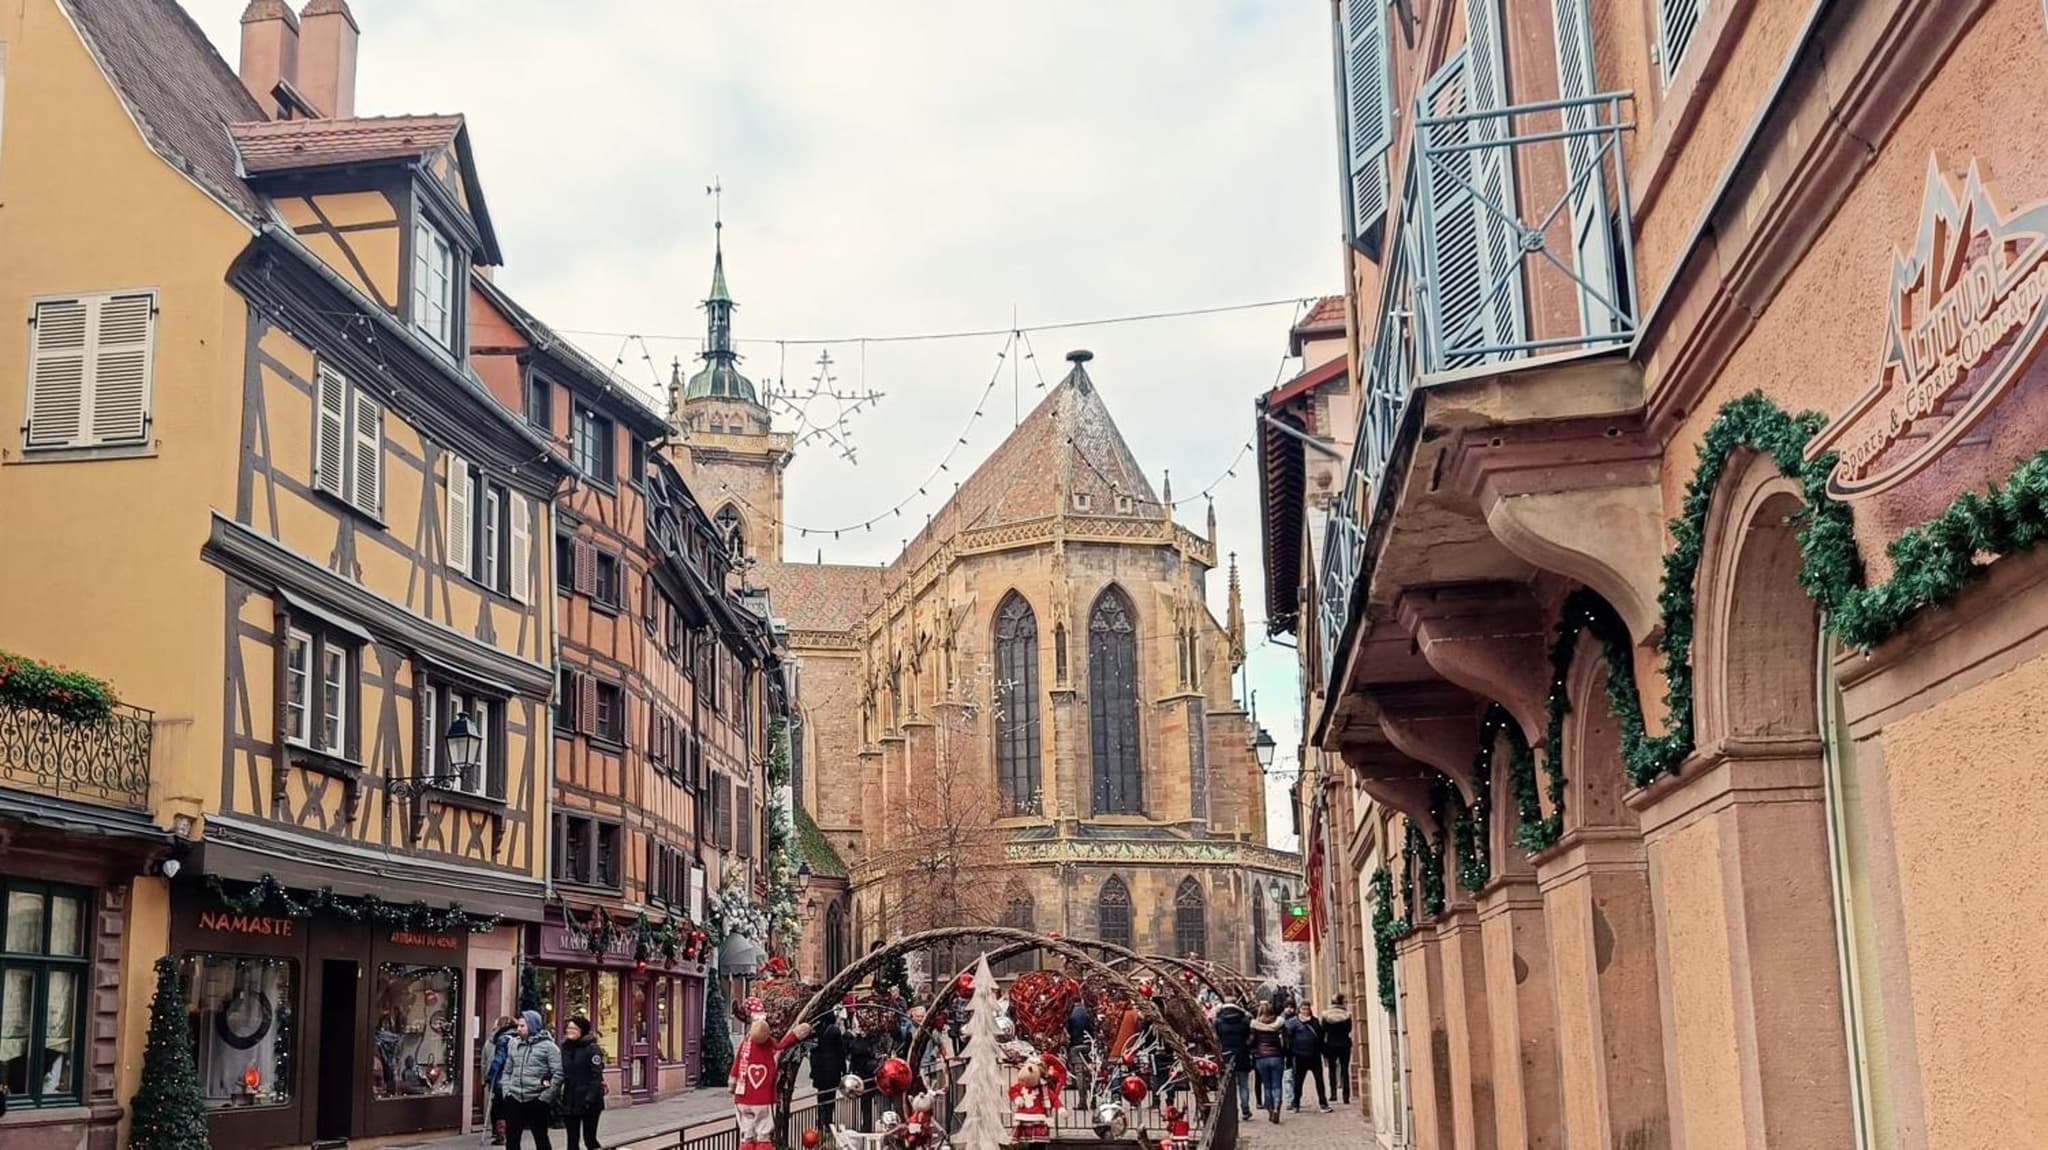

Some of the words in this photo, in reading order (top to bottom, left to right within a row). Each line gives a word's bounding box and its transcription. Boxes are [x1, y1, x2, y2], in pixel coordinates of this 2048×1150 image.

[1883, 246, 2007, 384] ALTITUDE
[1841, 429, 1884, 476] Sports
[1889, 408, 1899, 433] &
[1906, 361, 1956, 416] Esprit
[198, 911, 294, 937] NAMASTE
